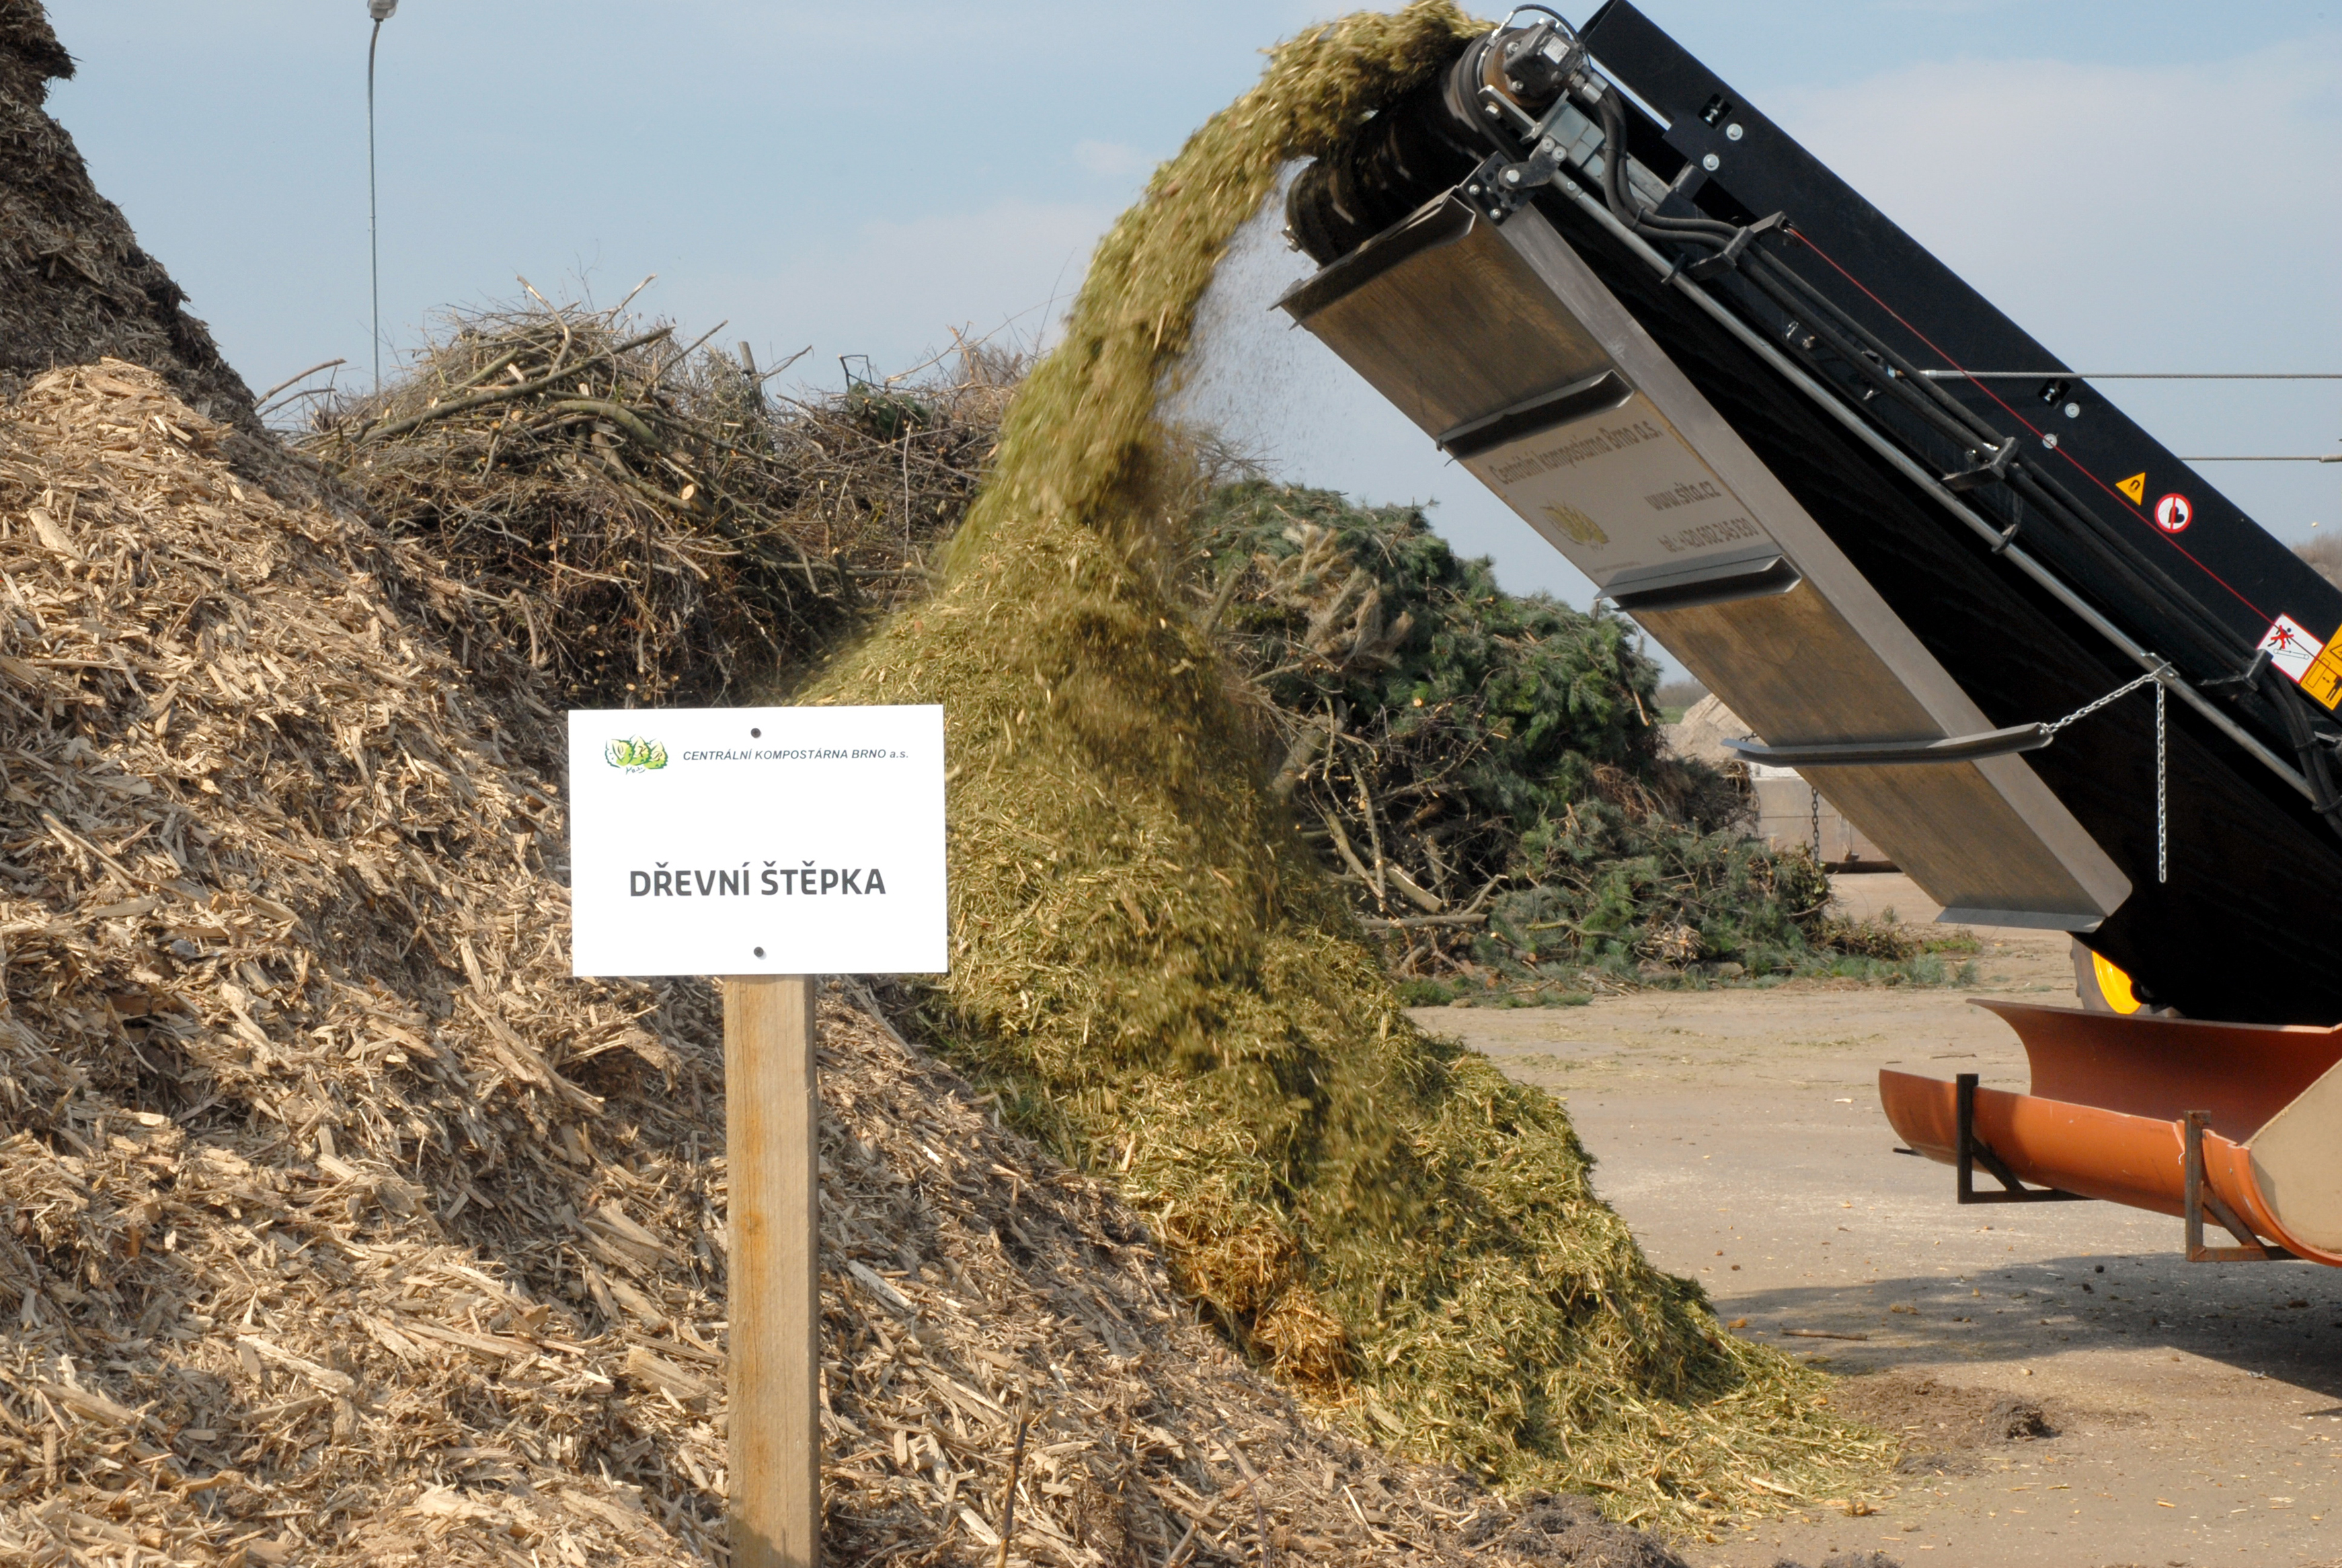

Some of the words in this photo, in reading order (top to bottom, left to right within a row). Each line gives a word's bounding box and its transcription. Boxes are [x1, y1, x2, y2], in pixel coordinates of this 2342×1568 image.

[1532, 435, 1613, 468] kompostárna
[1598, 428, 1640, 450] Brno
[1633, 421, 1664, 441] a.s.
[1644, 481, 1721, 511] www.sita.cz
[1678, 529, 1706, 548] +420
[1696, 525, 1724, 545] 602
[1712, 521, 1740, 541] 345
[1731, 518, 1759, 537] 830
[683, 749, 752, 760] CENTRÁLNÍ
[755, 748, 848, 760] KOMPOSTÁRNA
[851, 749, 886, 759] BRNO
[630, 861, 750, 896] DŘEVNÍ
[761, 860, 886, 896] ŠTĚPKA
